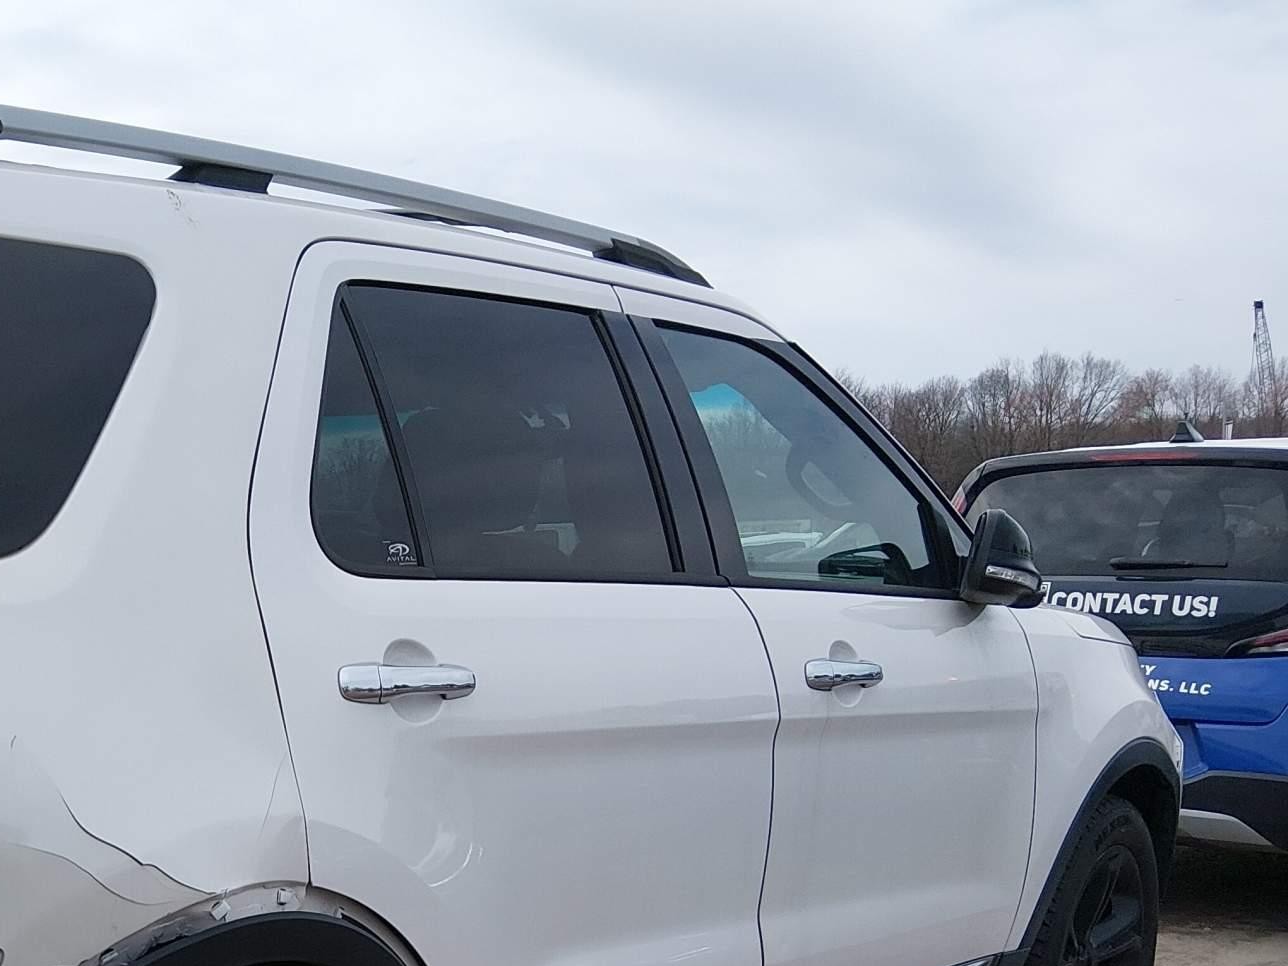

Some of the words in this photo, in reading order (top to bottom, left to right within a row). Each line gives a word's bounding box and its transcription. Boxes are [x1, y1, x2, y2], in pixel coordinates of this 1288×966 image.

[1051, 591, 1169, 616] CONTACT
[1171, 594, 1219, 618] US!
[1178, 681, 1212, 695] LLC
